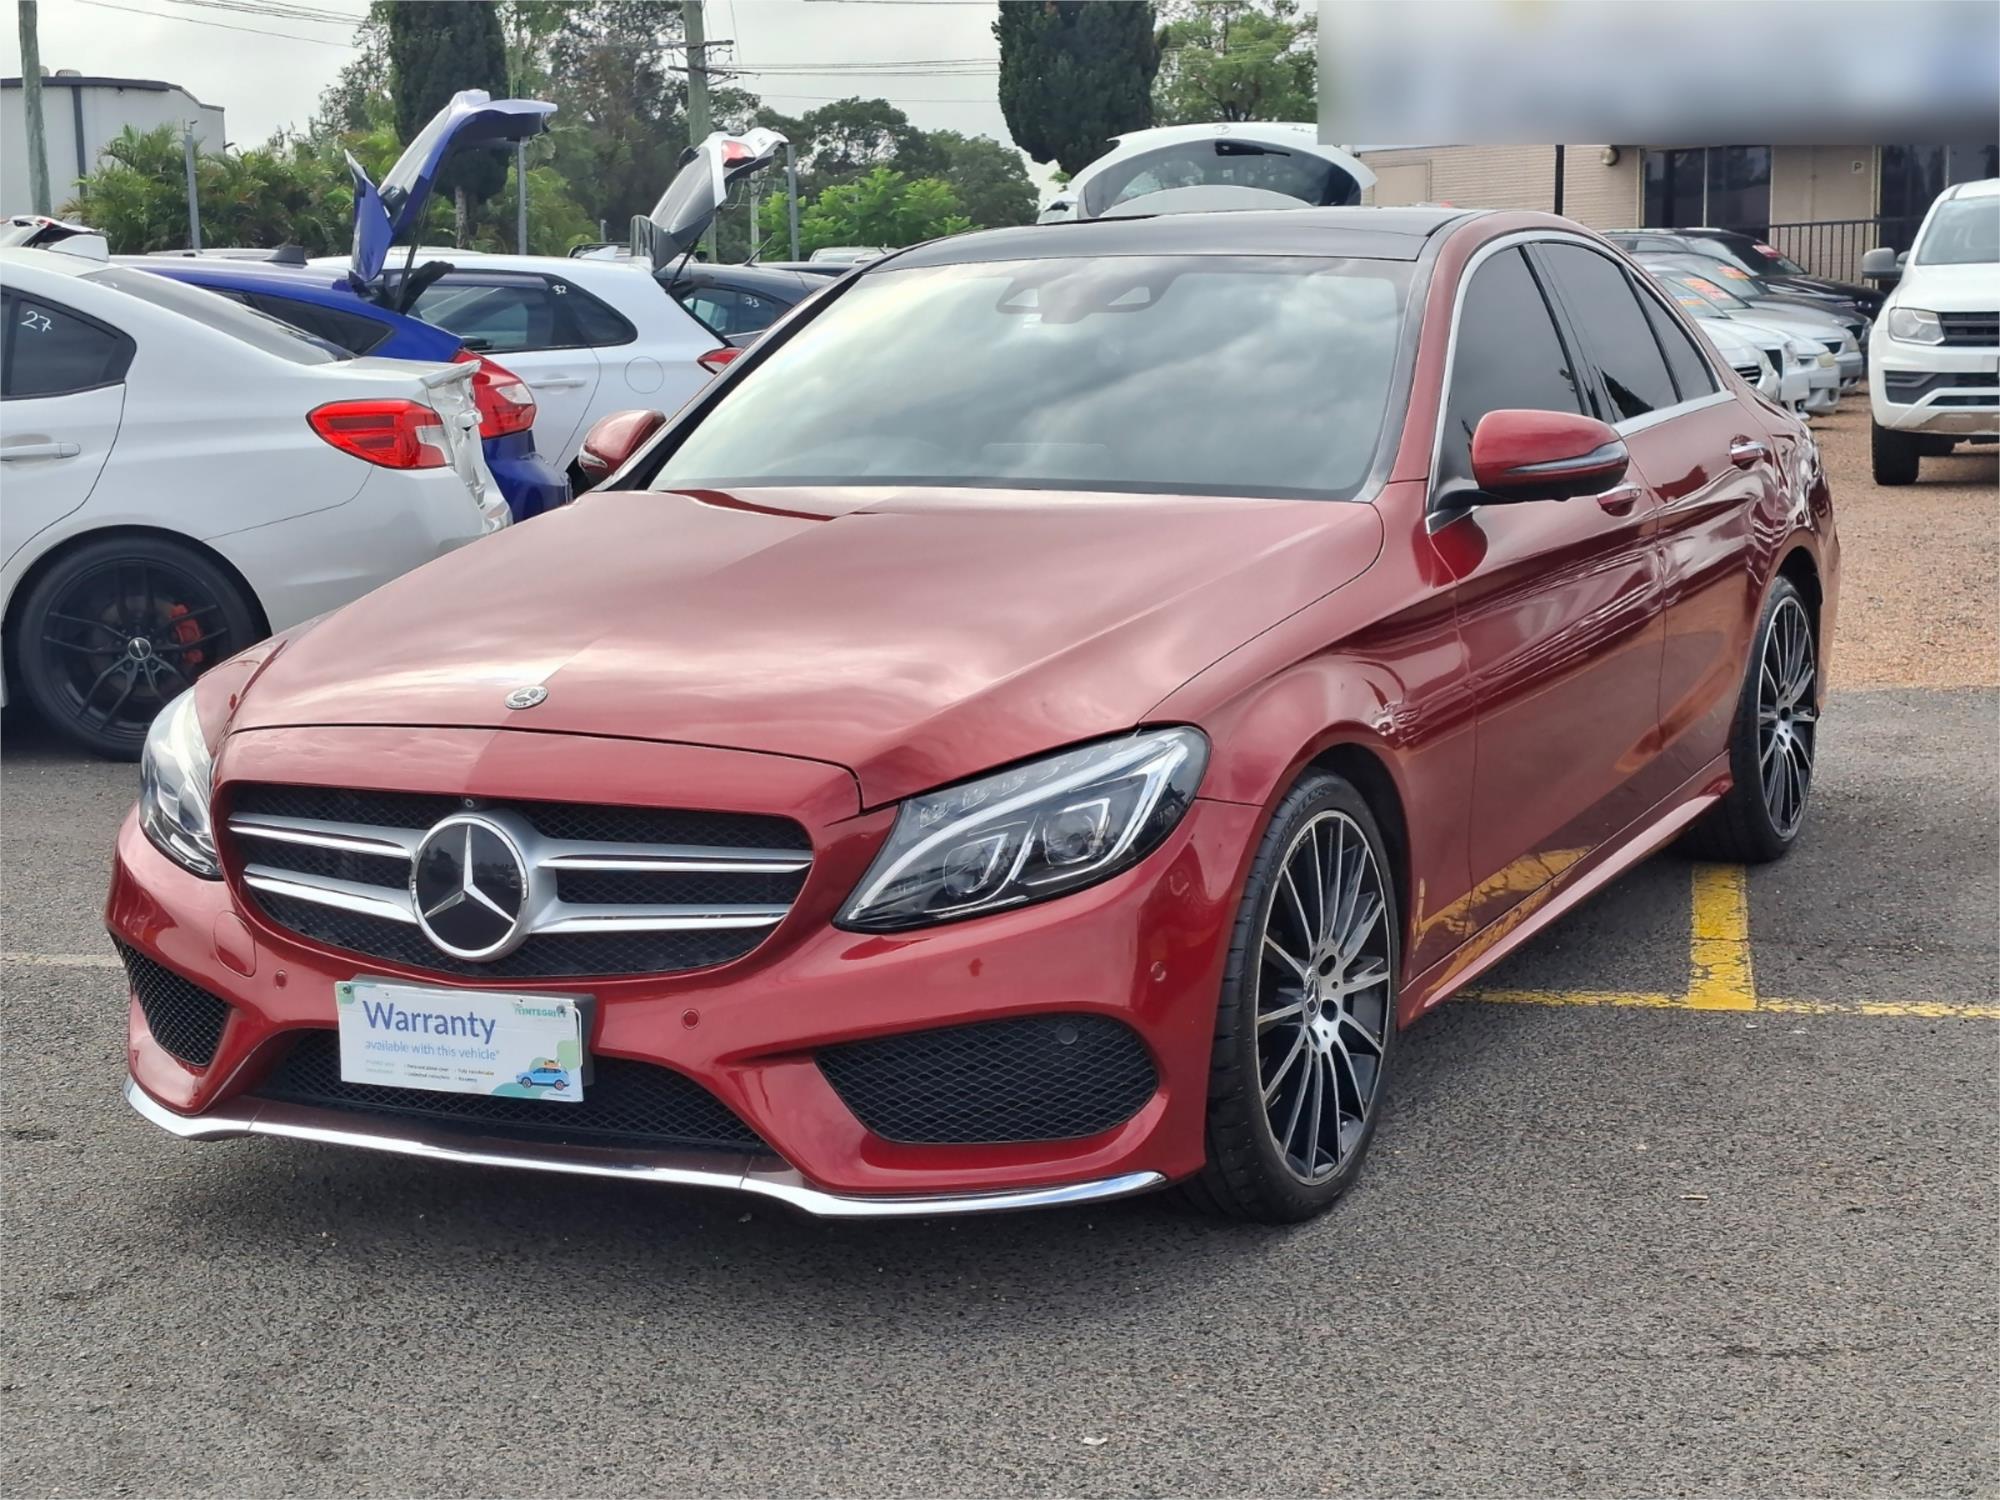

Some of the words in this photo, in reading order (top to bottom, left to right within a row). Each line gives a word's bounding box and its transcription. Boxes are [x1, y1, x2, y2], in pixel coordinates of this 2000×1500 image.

[20, 310, 53, 332] 27
[362, 1000, 496, 1045] Warranty
[365, 1040, 409, 1052] available
[411, 1043, 434, 1055] with
[437, 1045, 456, 1057] this
